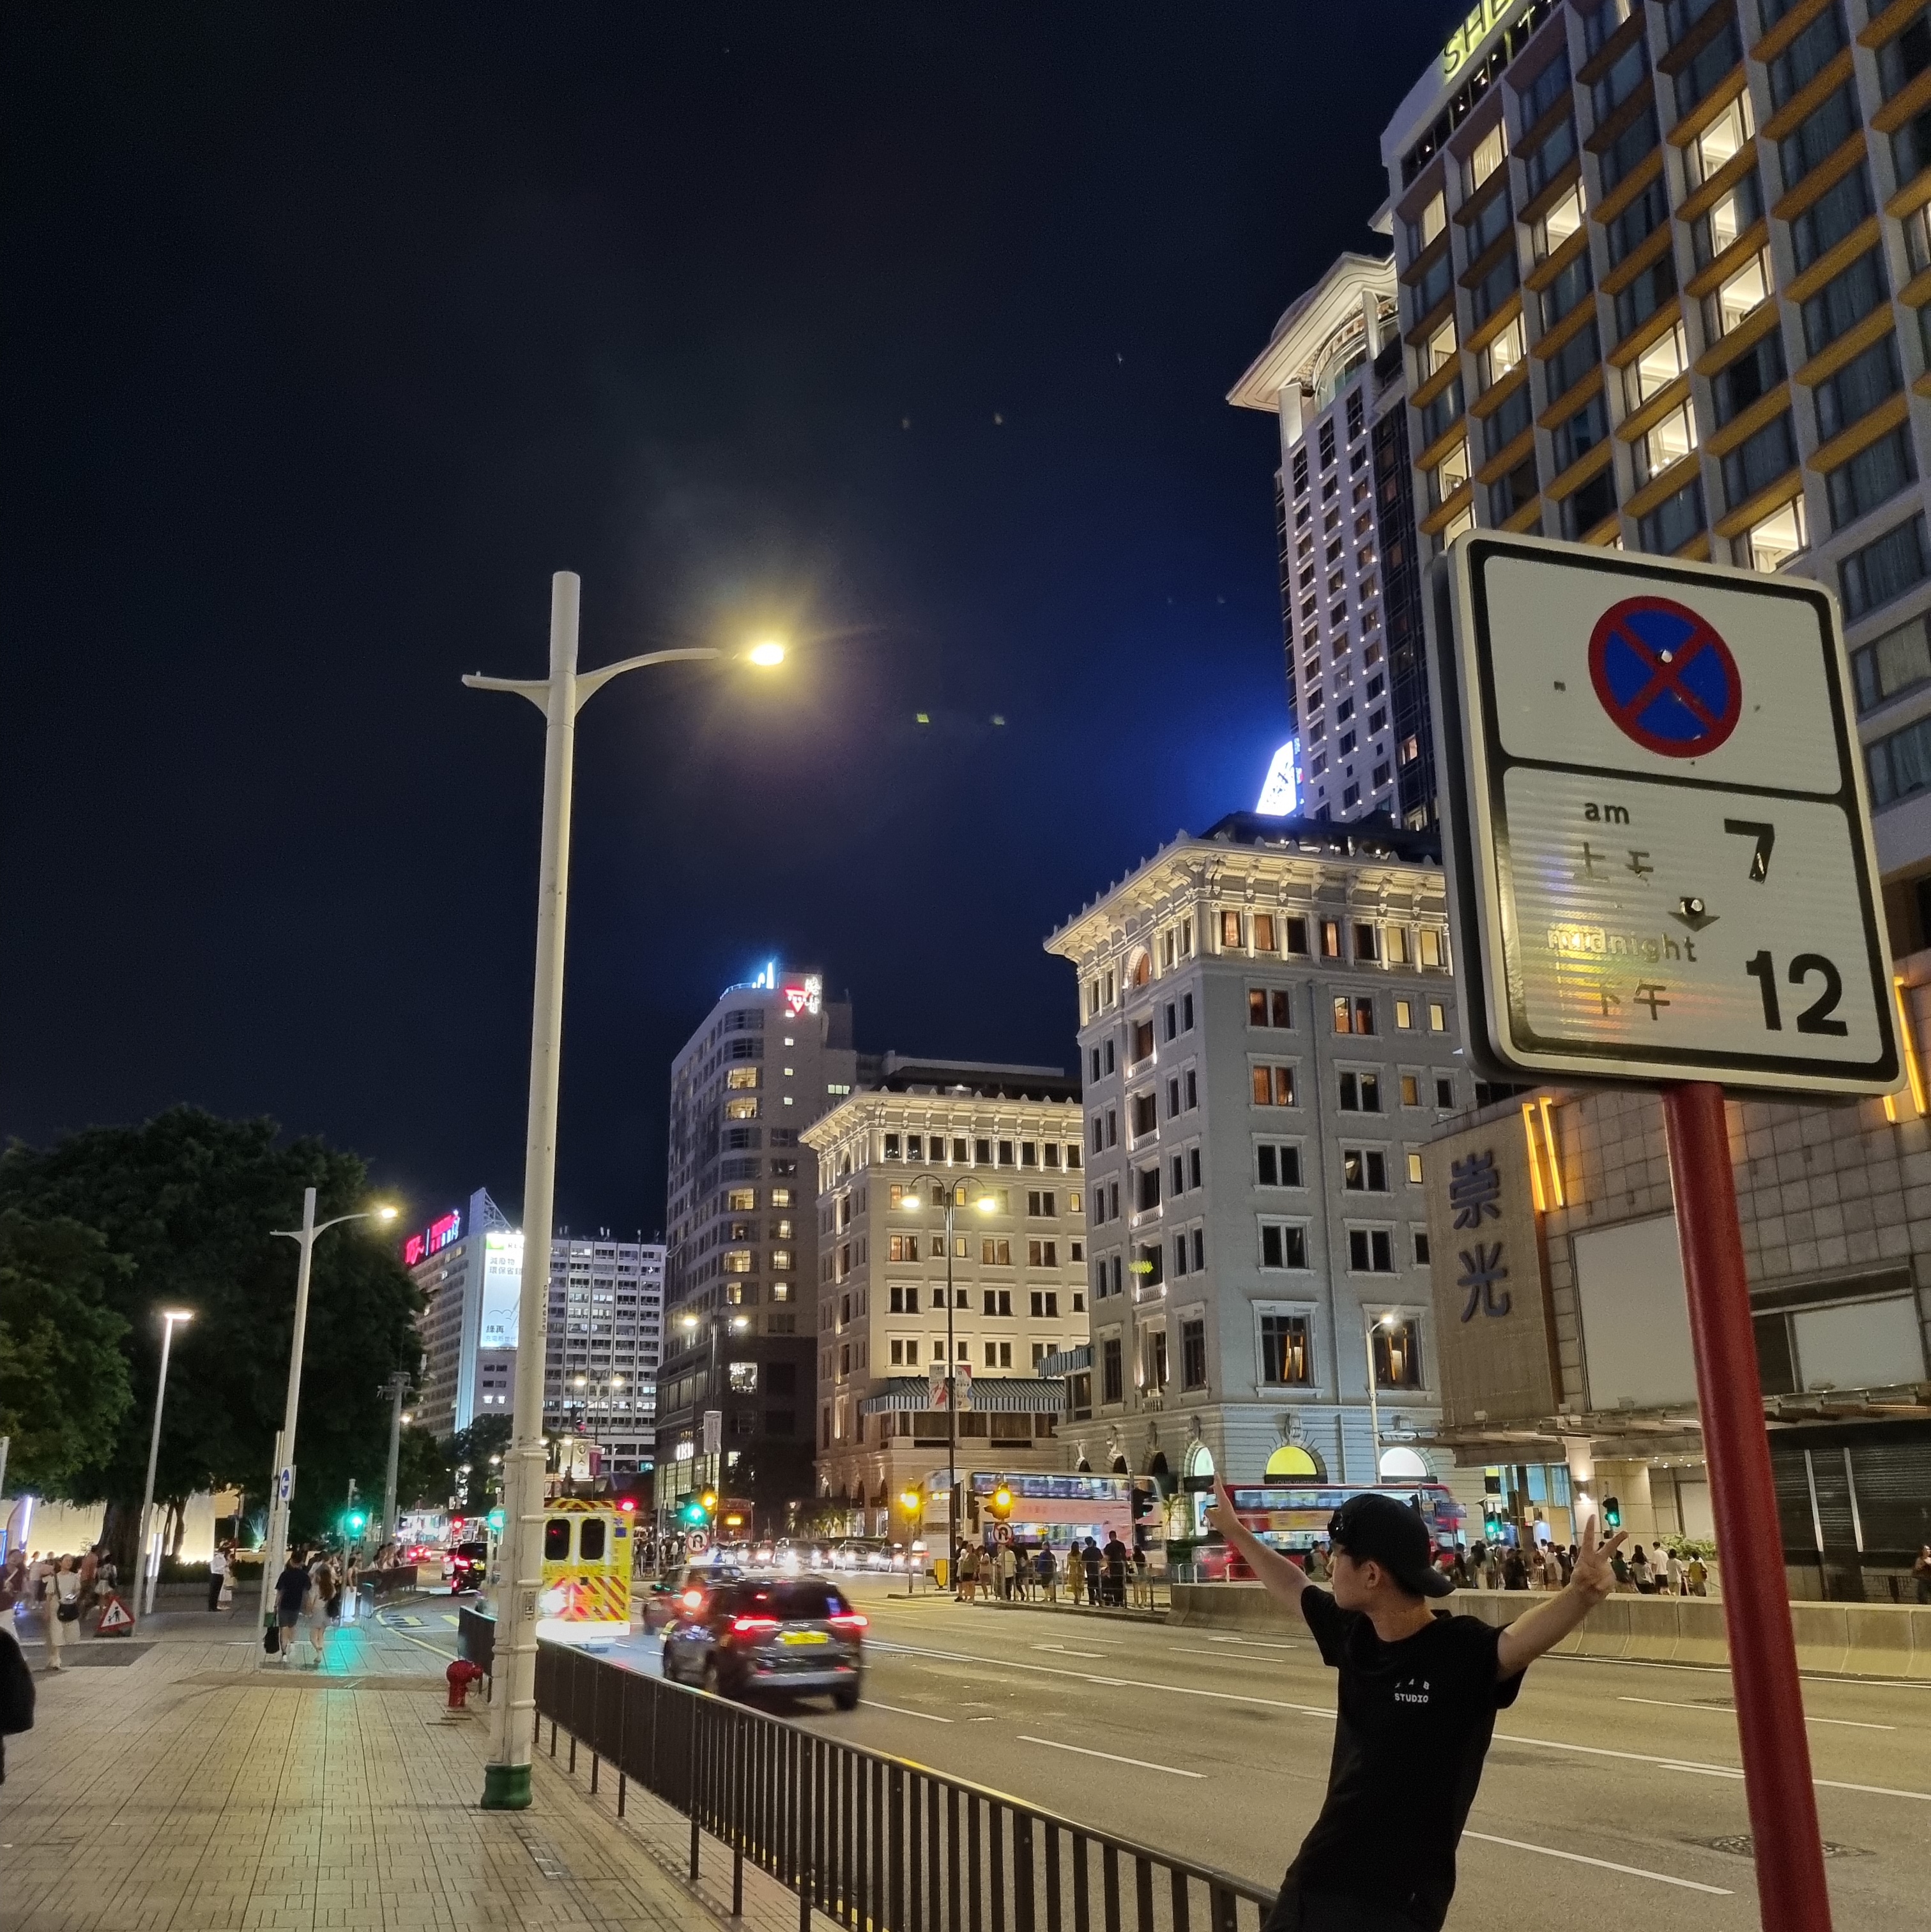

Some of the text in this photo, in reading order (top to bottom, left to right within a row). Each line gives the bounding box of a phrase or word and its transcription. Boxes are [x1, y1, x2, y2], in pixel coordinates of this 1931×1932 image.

[1584, 802, 1630, 825] am
[1724, 818, 1775, 883] 7
[1546, 927, 1698, 964] midnight
[1745, 949, 1849, 1037] 12
[1449, 1150, 1511, 1323] 崇光
[1394, 1693, 1429, 1703] STUDIO
